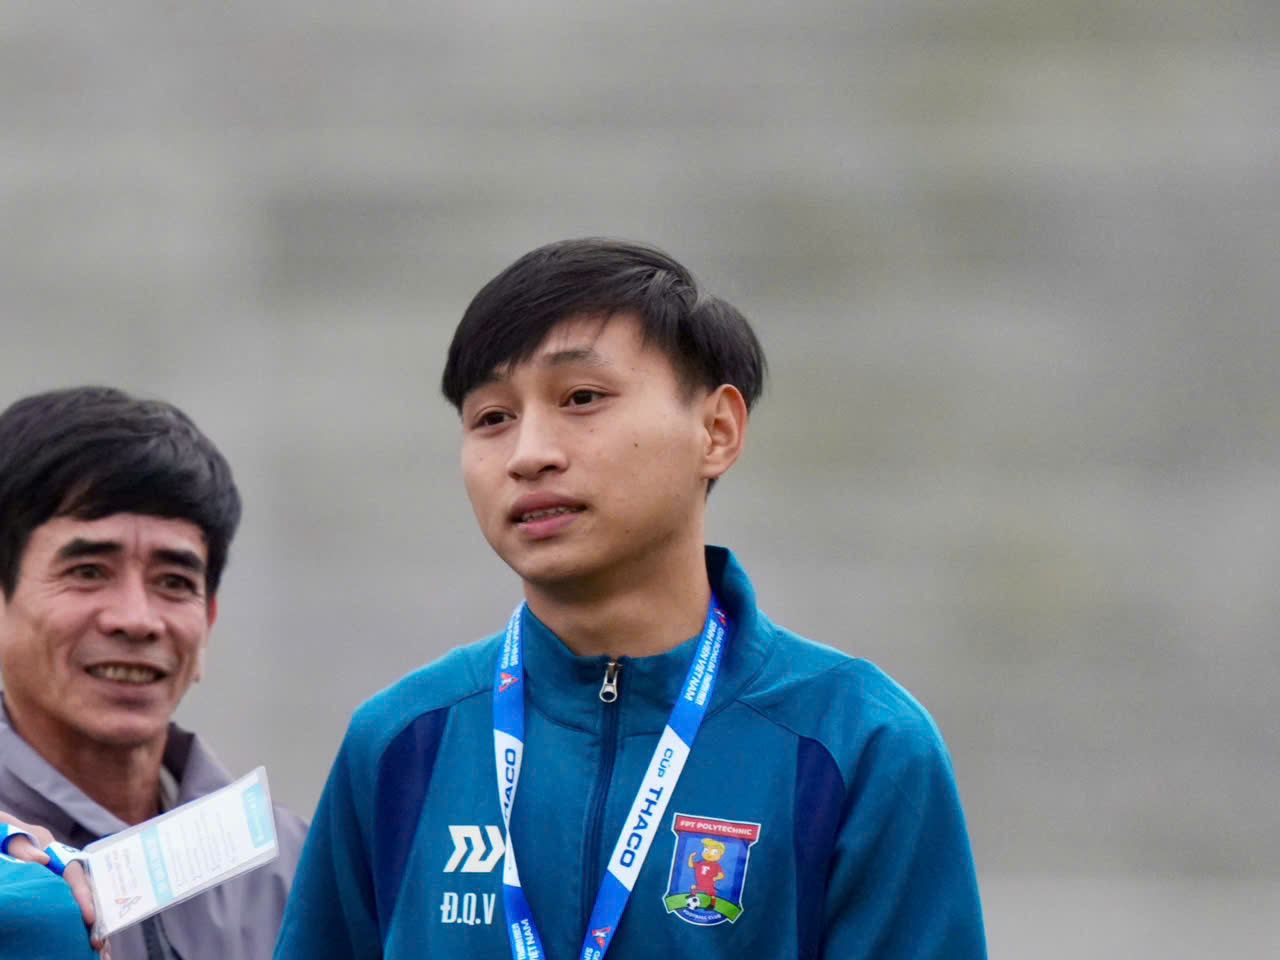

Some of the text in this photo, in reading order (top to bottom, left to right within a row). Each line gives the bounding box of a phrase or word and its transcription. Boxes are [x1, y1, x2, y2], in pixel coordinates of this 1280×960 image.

[619, 786, 664, 868] THACO
[680, 820, 753, 836] FPT POLYTECHNIC
[440, 892, 496, 926] Đ.Q.V
[521, 918, 535, 945] NAM
